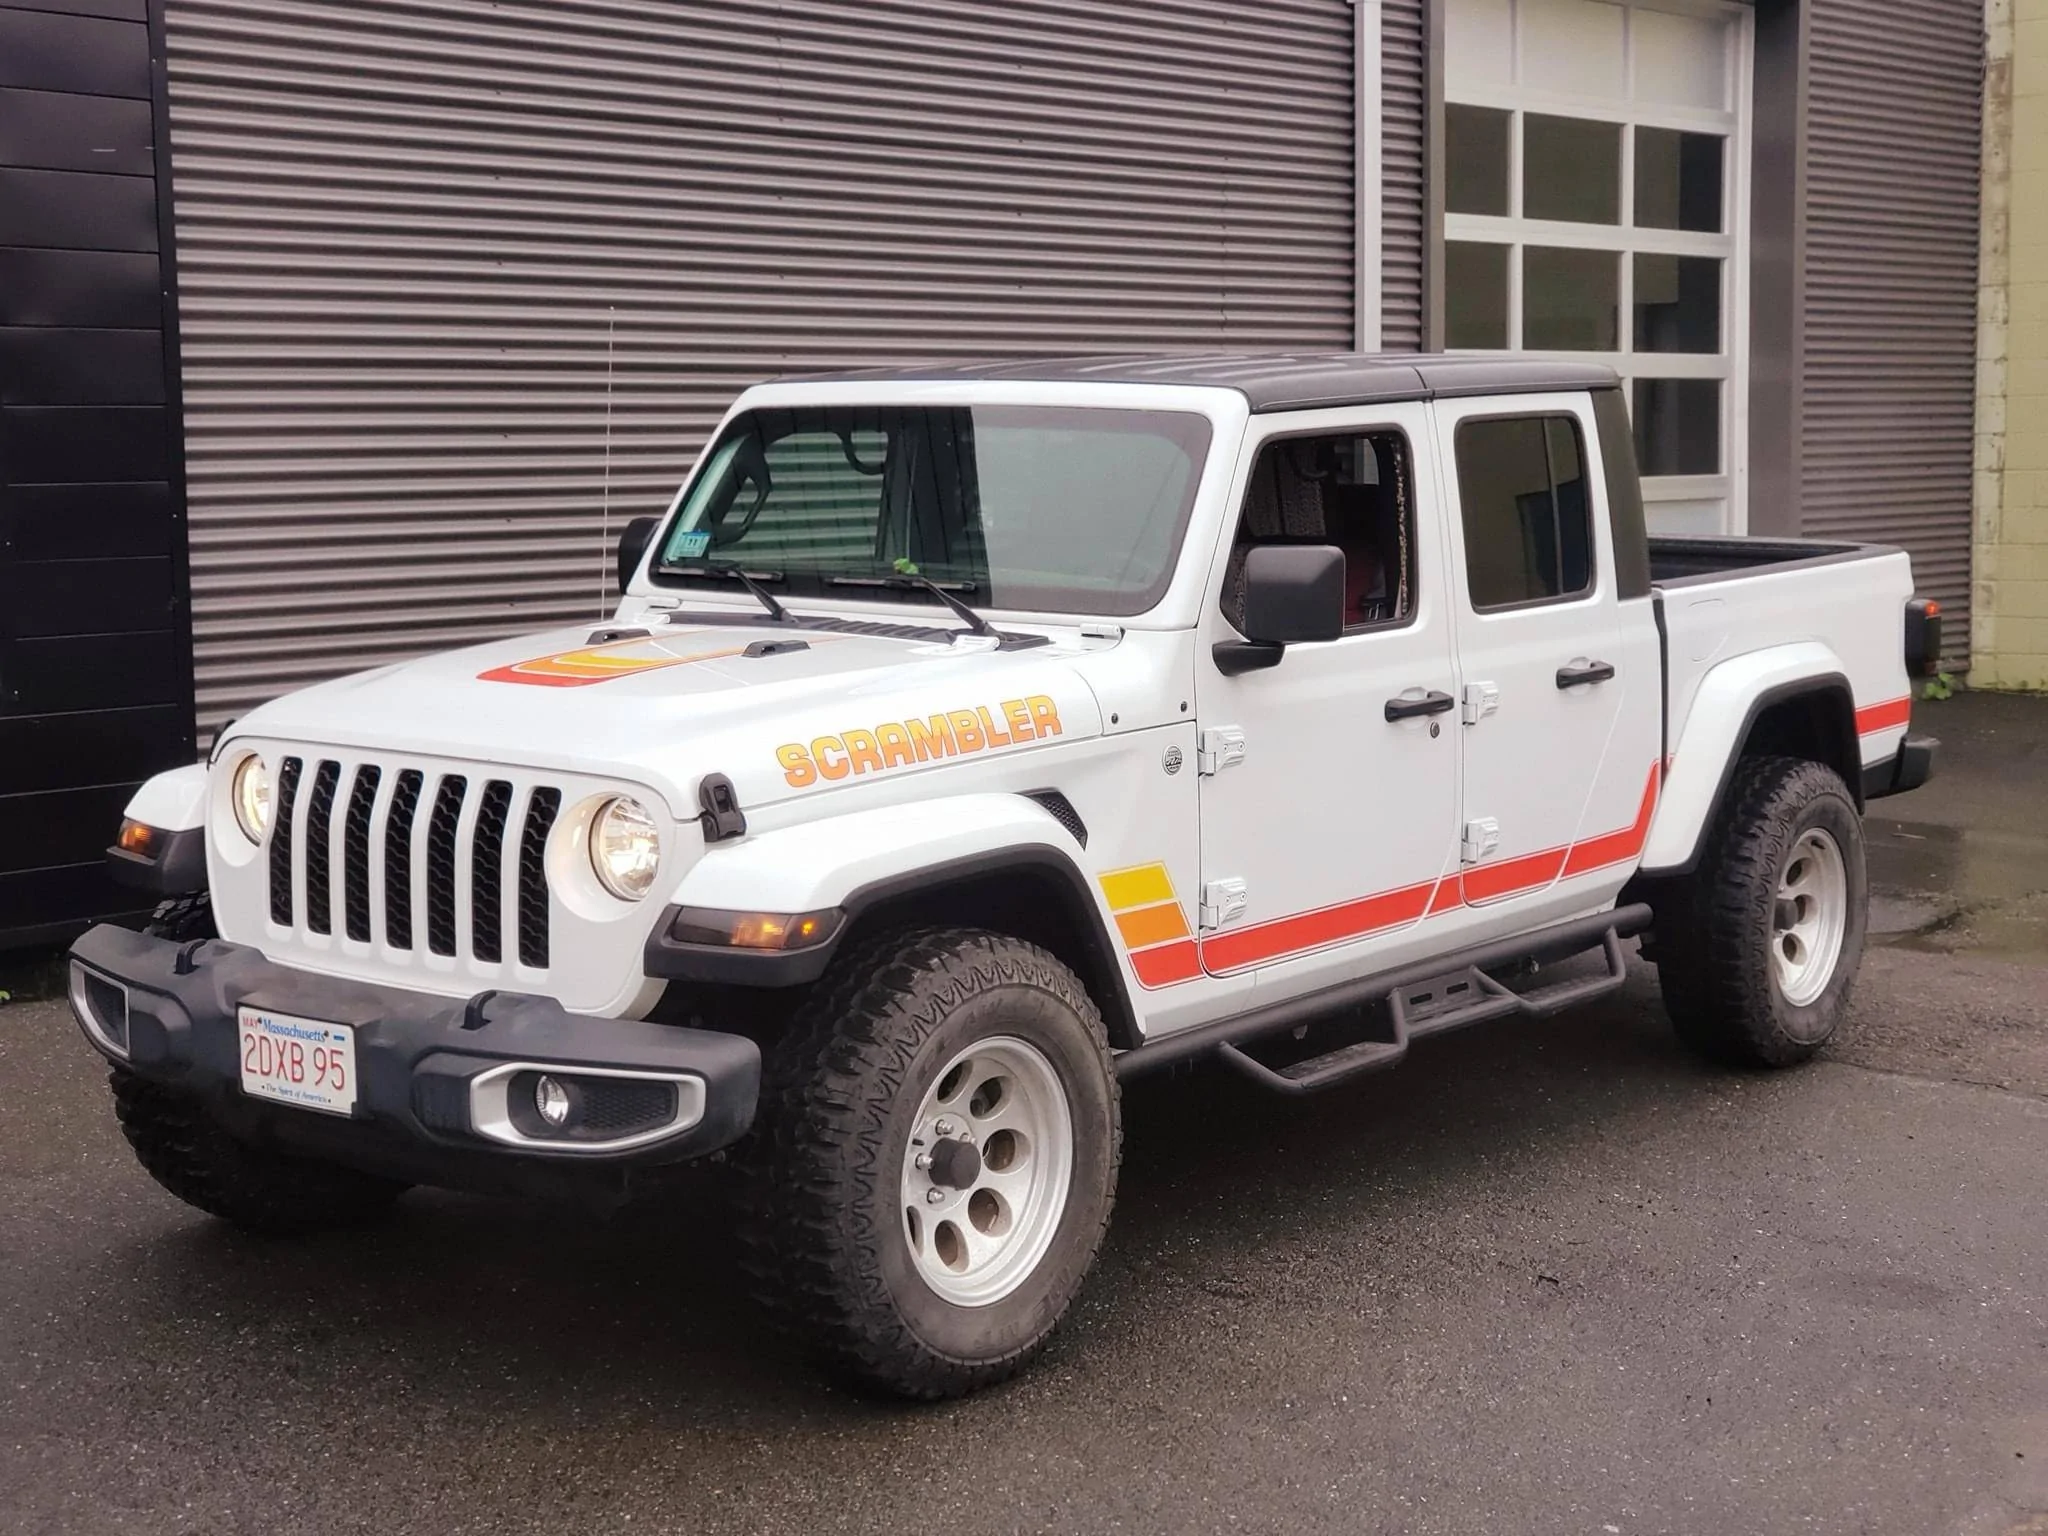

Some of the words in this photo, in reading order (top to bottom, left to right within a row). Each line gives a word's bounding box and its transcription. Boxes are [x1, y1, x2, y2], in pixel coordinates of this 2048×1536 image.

[776, 695, 1063, 788] SCRAMBLER
[242, 1016, 259, 1029] MAY
[263, 1016, 326, 1043] Massachusetts
[244, 1032, 305, 1083] 2DXB
[313, 1047, 345, 1091] 95
